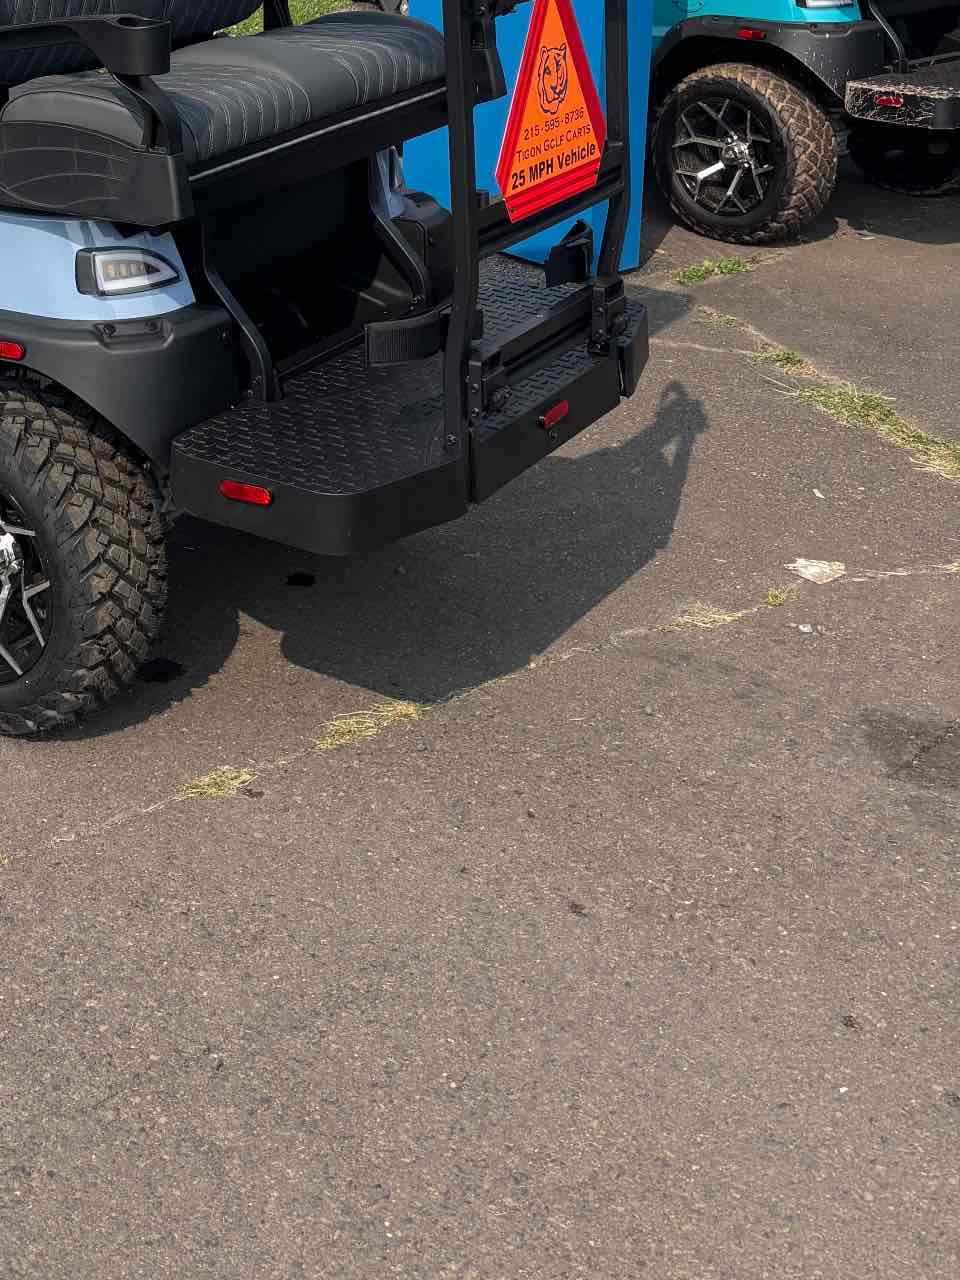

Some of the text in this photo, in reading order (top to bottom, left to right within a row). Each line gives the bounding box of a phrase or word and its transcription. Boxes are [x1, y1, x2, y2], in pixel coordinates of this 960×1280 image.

[516, 144, 542, 162] TIGON
[566, 124, 591, 142] CARTS
[512, 142, 596, 190] 25 MPH Vehicle
